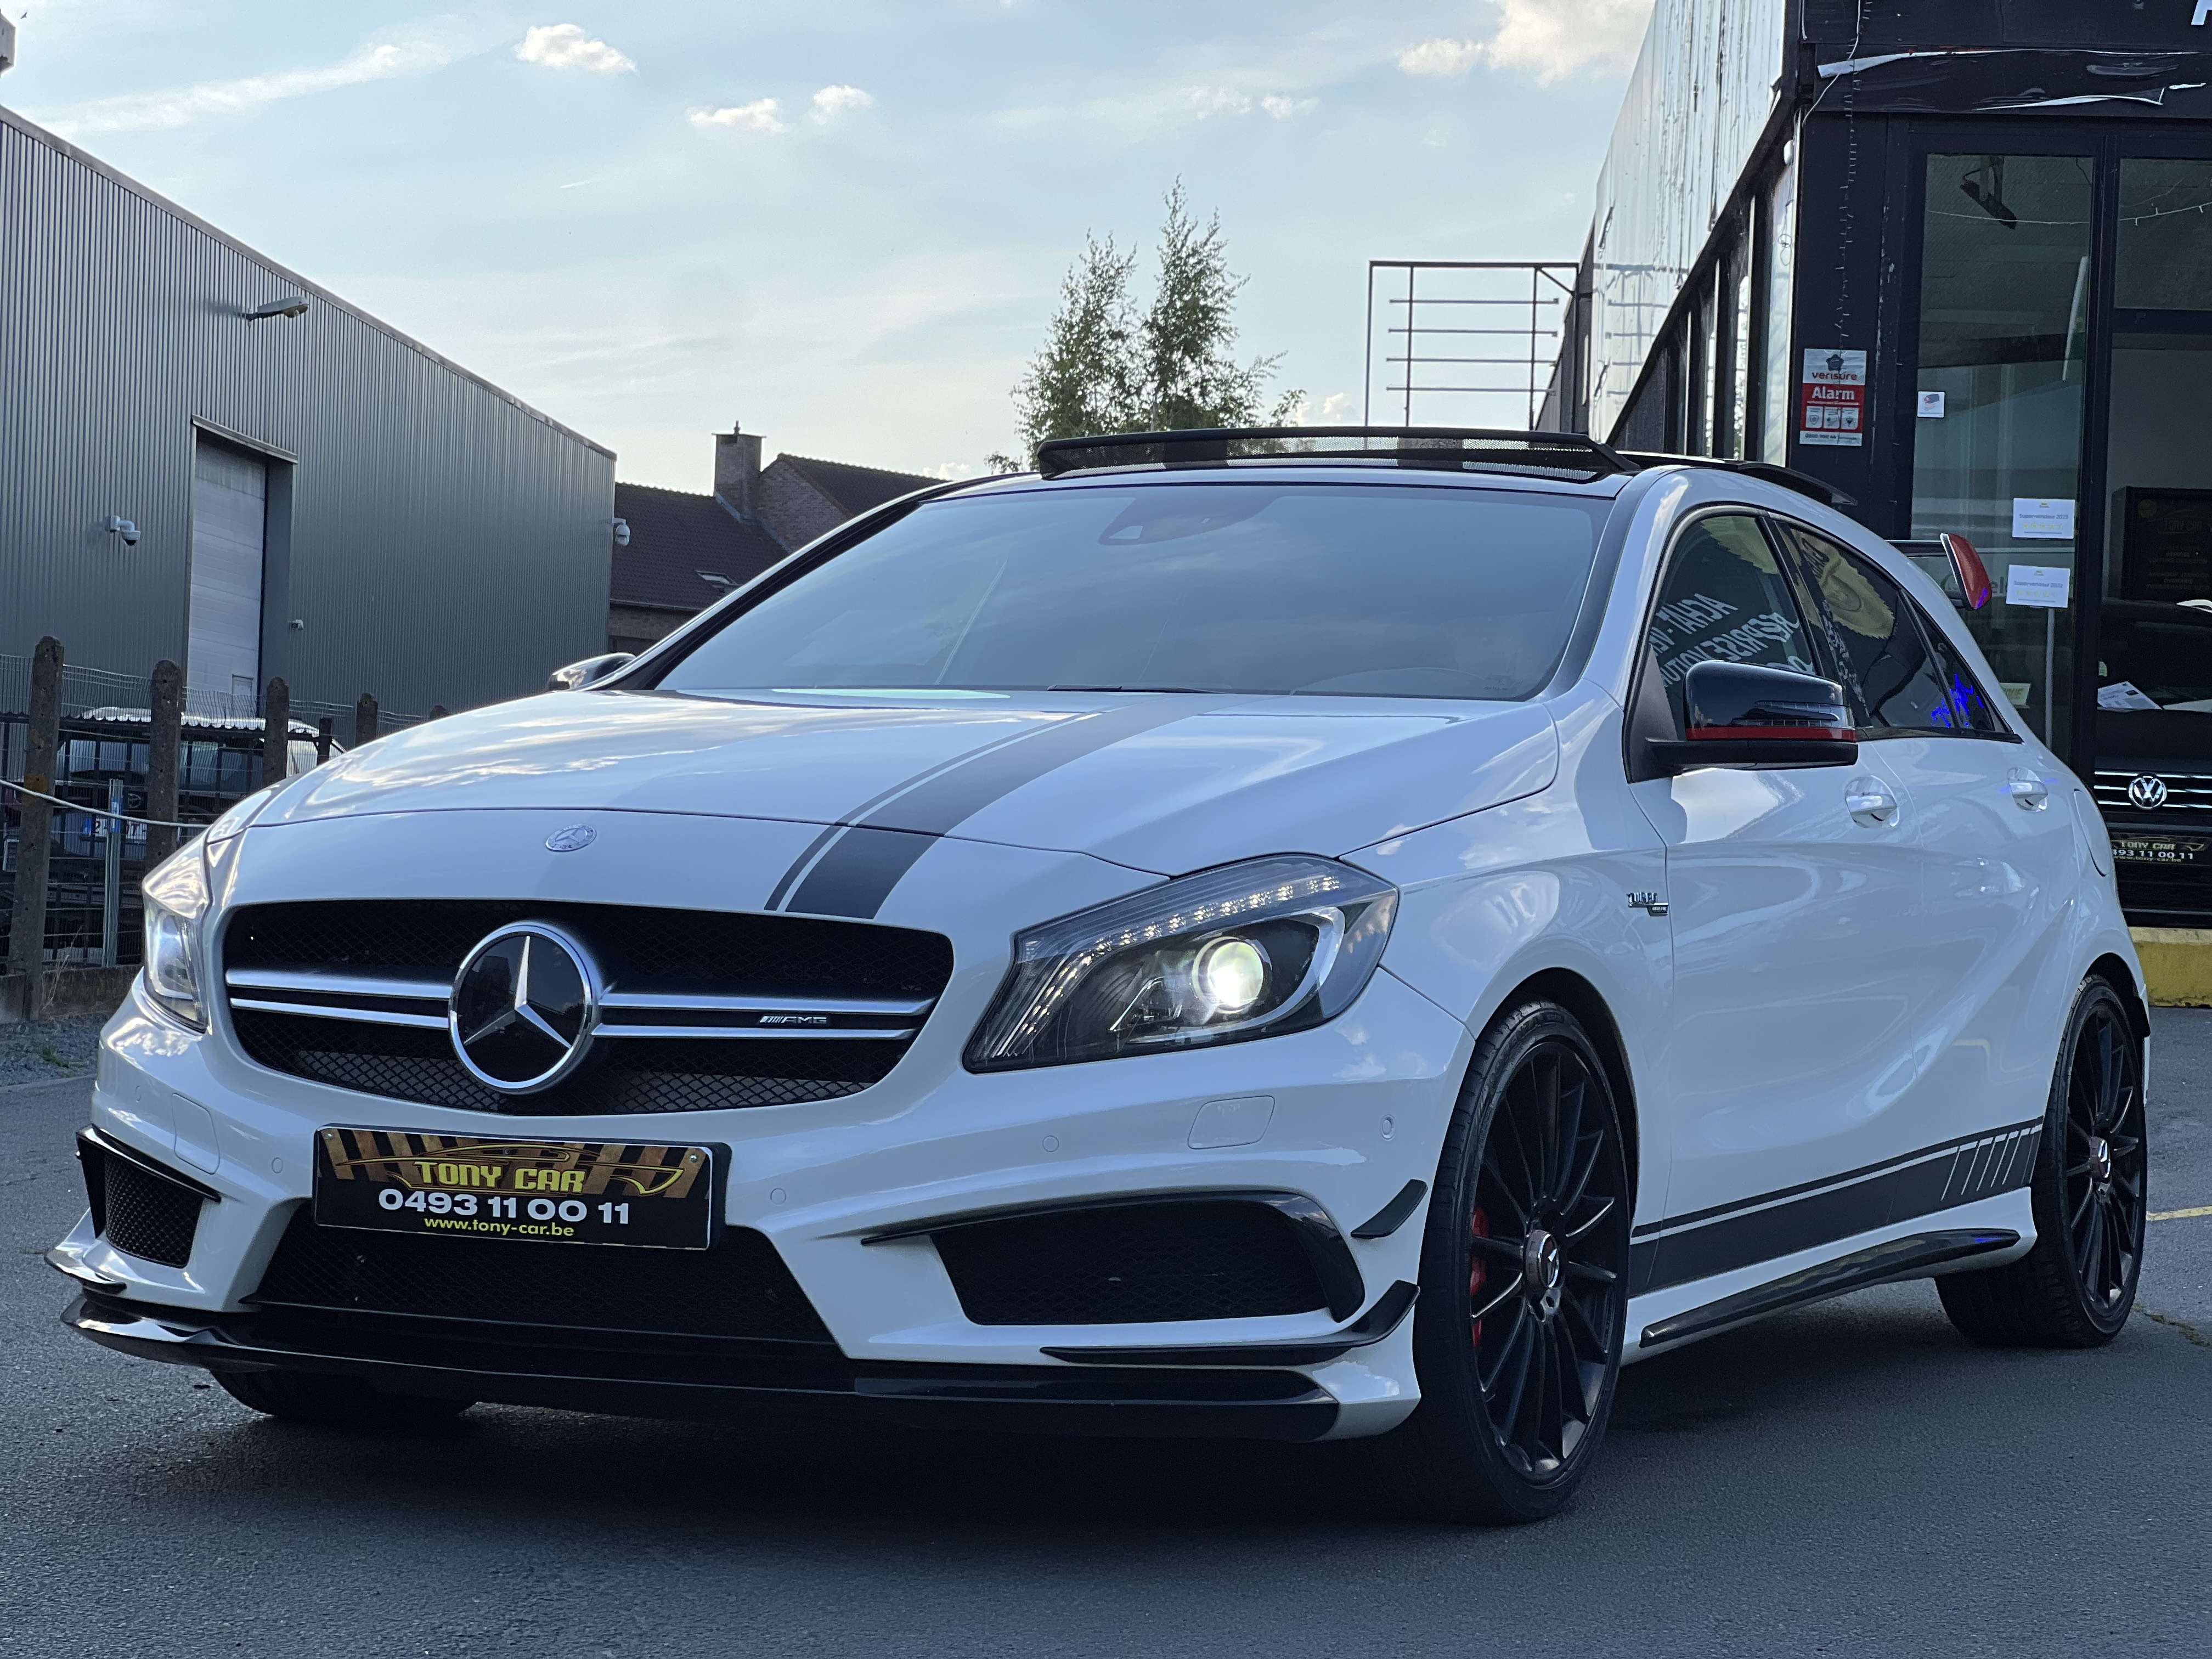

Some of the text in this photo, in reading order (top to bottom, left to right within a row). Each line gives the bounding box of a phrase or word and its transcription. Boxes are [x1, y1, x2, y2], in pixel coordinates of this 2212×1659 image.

[1812, 371, 1857, 381] verisure
[1812, 386, 1855, 400] Alarm
[780, 1015, 827, 1024] AMG
[413, 1161, 586, 1194] TONY CAR
[379, 1188, 629, 1224] 0493 11 00 11
[424, 1216, 574, 1237] www.tony-car.be
